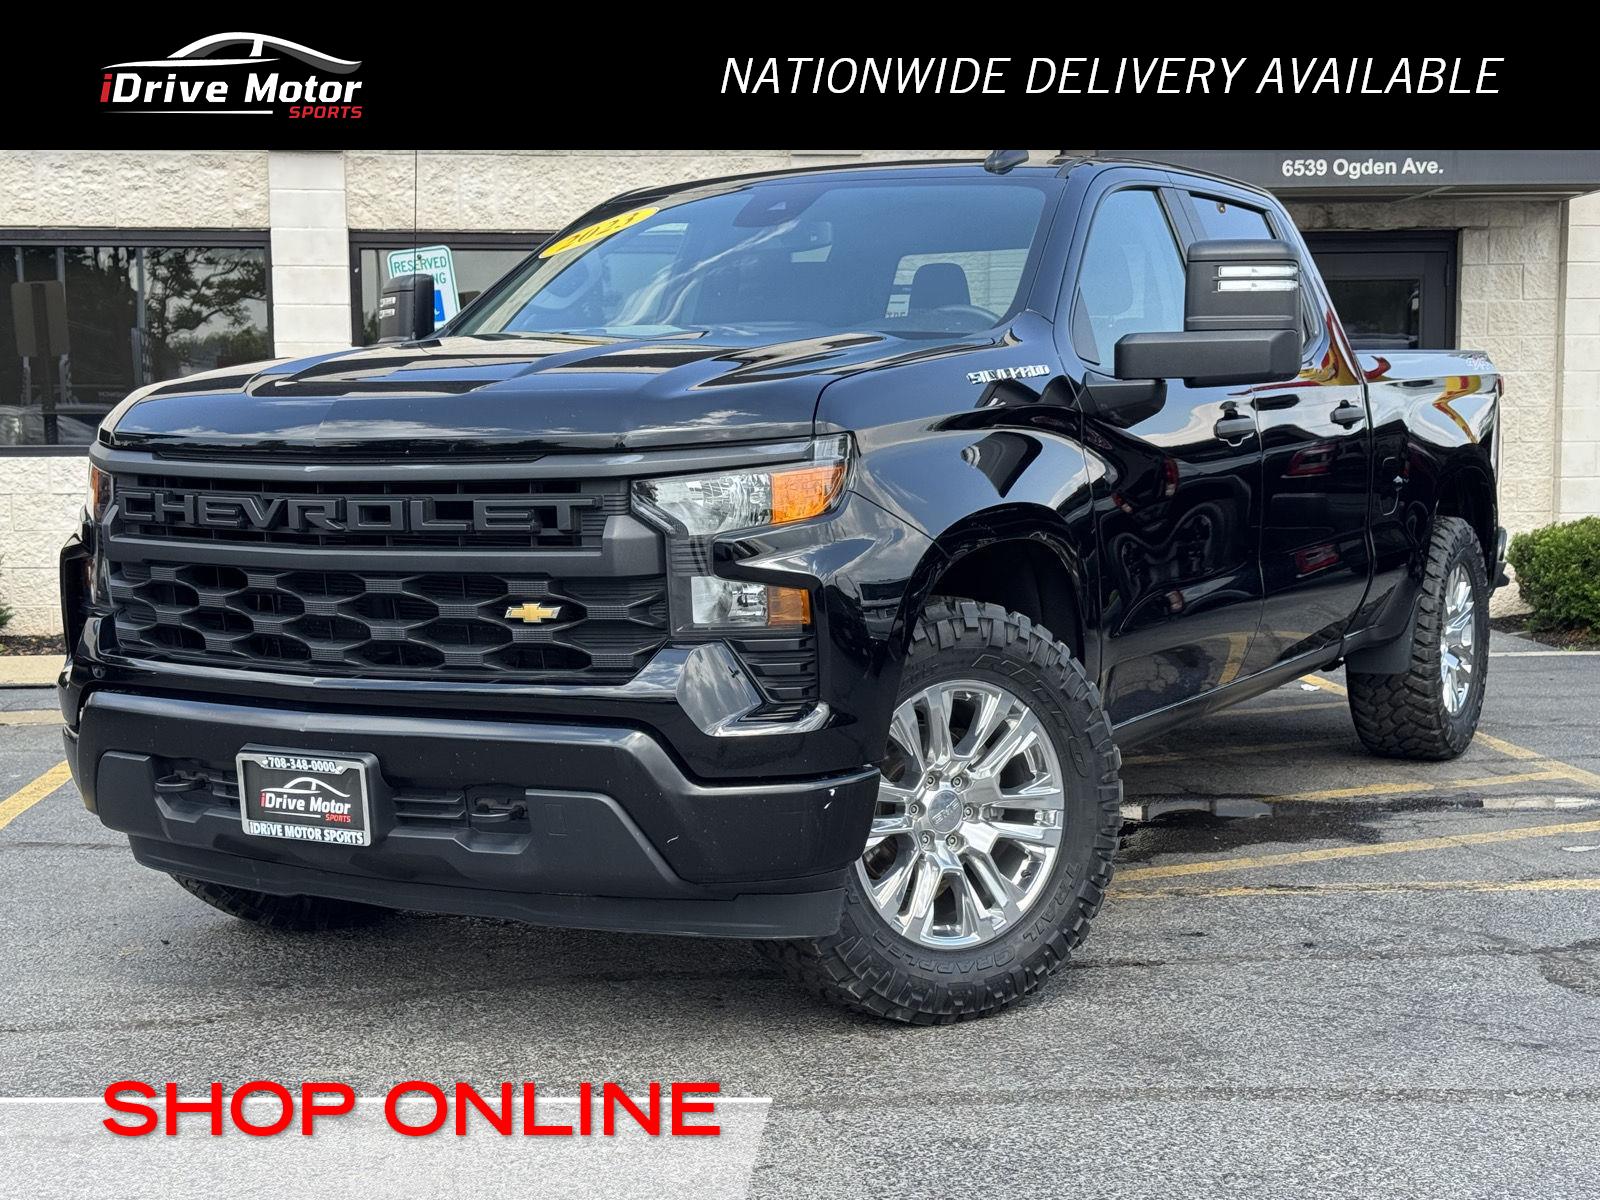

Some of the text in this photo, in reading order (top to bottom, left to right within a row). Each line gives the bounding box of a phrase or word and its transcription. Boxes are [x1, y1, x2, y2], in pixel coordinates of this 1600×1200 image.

[1282, 157, 1444, 180] 6539 Ogden Ave.
[554, 212, 640, 252] 2023
[393, 256, 447, 274] RESERVED
[966, 364, 1051, 385] SILVERADO
[117, 490, 600, 533] CHEVROLET
[268, 757, 336, 772] 708-348-0000
[260, 792, 352, 815] iDrive Motor
[325, 813, 352, 823] SPORTS
[284, 824, 322, 841] MOTOR
[323, 830, 364, 844] SPORTS
